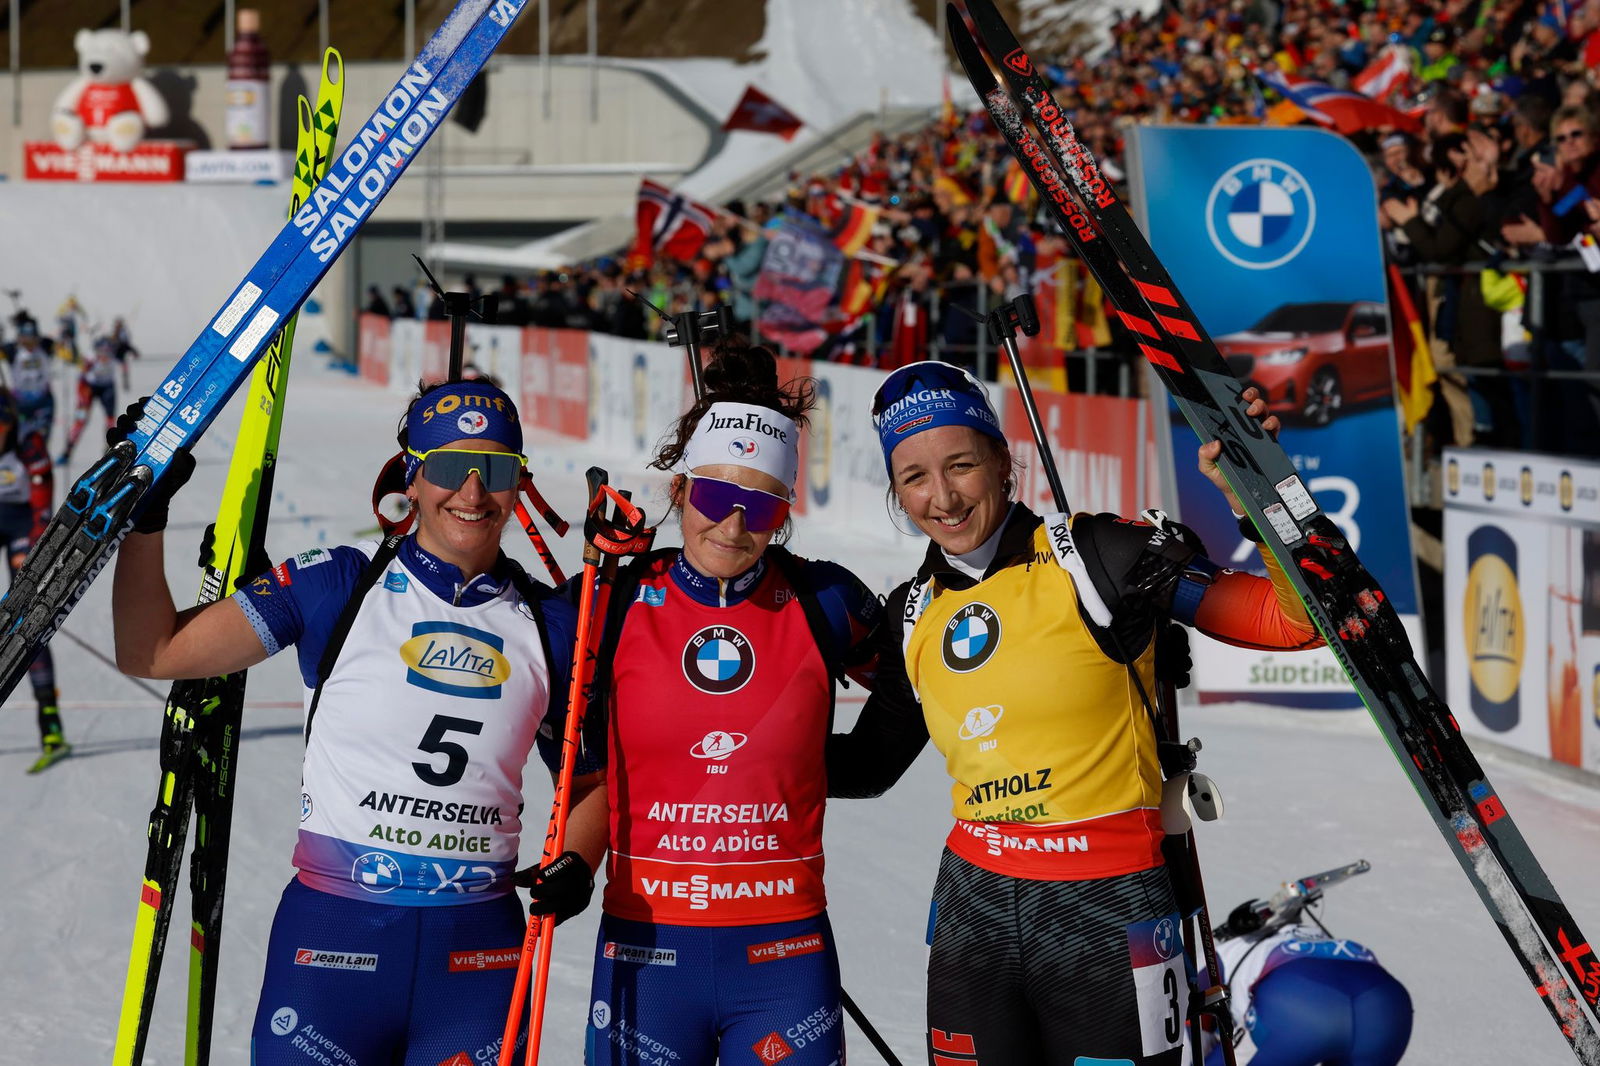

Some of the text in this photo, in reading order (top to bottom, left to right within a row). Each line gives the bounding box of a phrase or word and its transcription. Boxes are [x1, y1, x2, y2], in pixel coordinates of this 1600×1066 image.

[294, 62, 433, 237] SALOMON
[310, 87, 449, 263] SALOMON
[1221, 164, 1303, 196] BMW
[163, 379, 183, 399] 43
[179, 404, 201, 425] 43
[706, 412, 787, 444] JuraFlore
[1050, 523, 1074, 559] JOKA
[949, 606, 993, 630] BMW
[693, 628, 745, 648] BMW
[218, 723, 233, 798] FISCHER
[411, 713, 484, 787] 5
[979, 739, 998, 753] IBU
[706, 764, 728, 775] IBU
[359, 790, 502, 826] ANTERSELVA
[647, 801, 789, 824] ANTERSELVA
[1484, 803, 1495, 817] 3
[360, 854, 397, 872] BMW
[641, 874, 795, 910] VIESSMANN
[312, 953, 345, 964] Jean
[454, 952, 521, 969] VIESSMANN
[618, 946, 646, 958] Jean
[752, 936, 820, 958] VIESSMANN
[1163, 967, 1181, 1045] 3
[786, 1006, 829, 1039] CAISSE
[794, 1001, 842, 1049] D'EPARGN
[607, 1029, 671, 1066] Rhône-Al
[616, 1019, 681, 1060] Auvergne-
